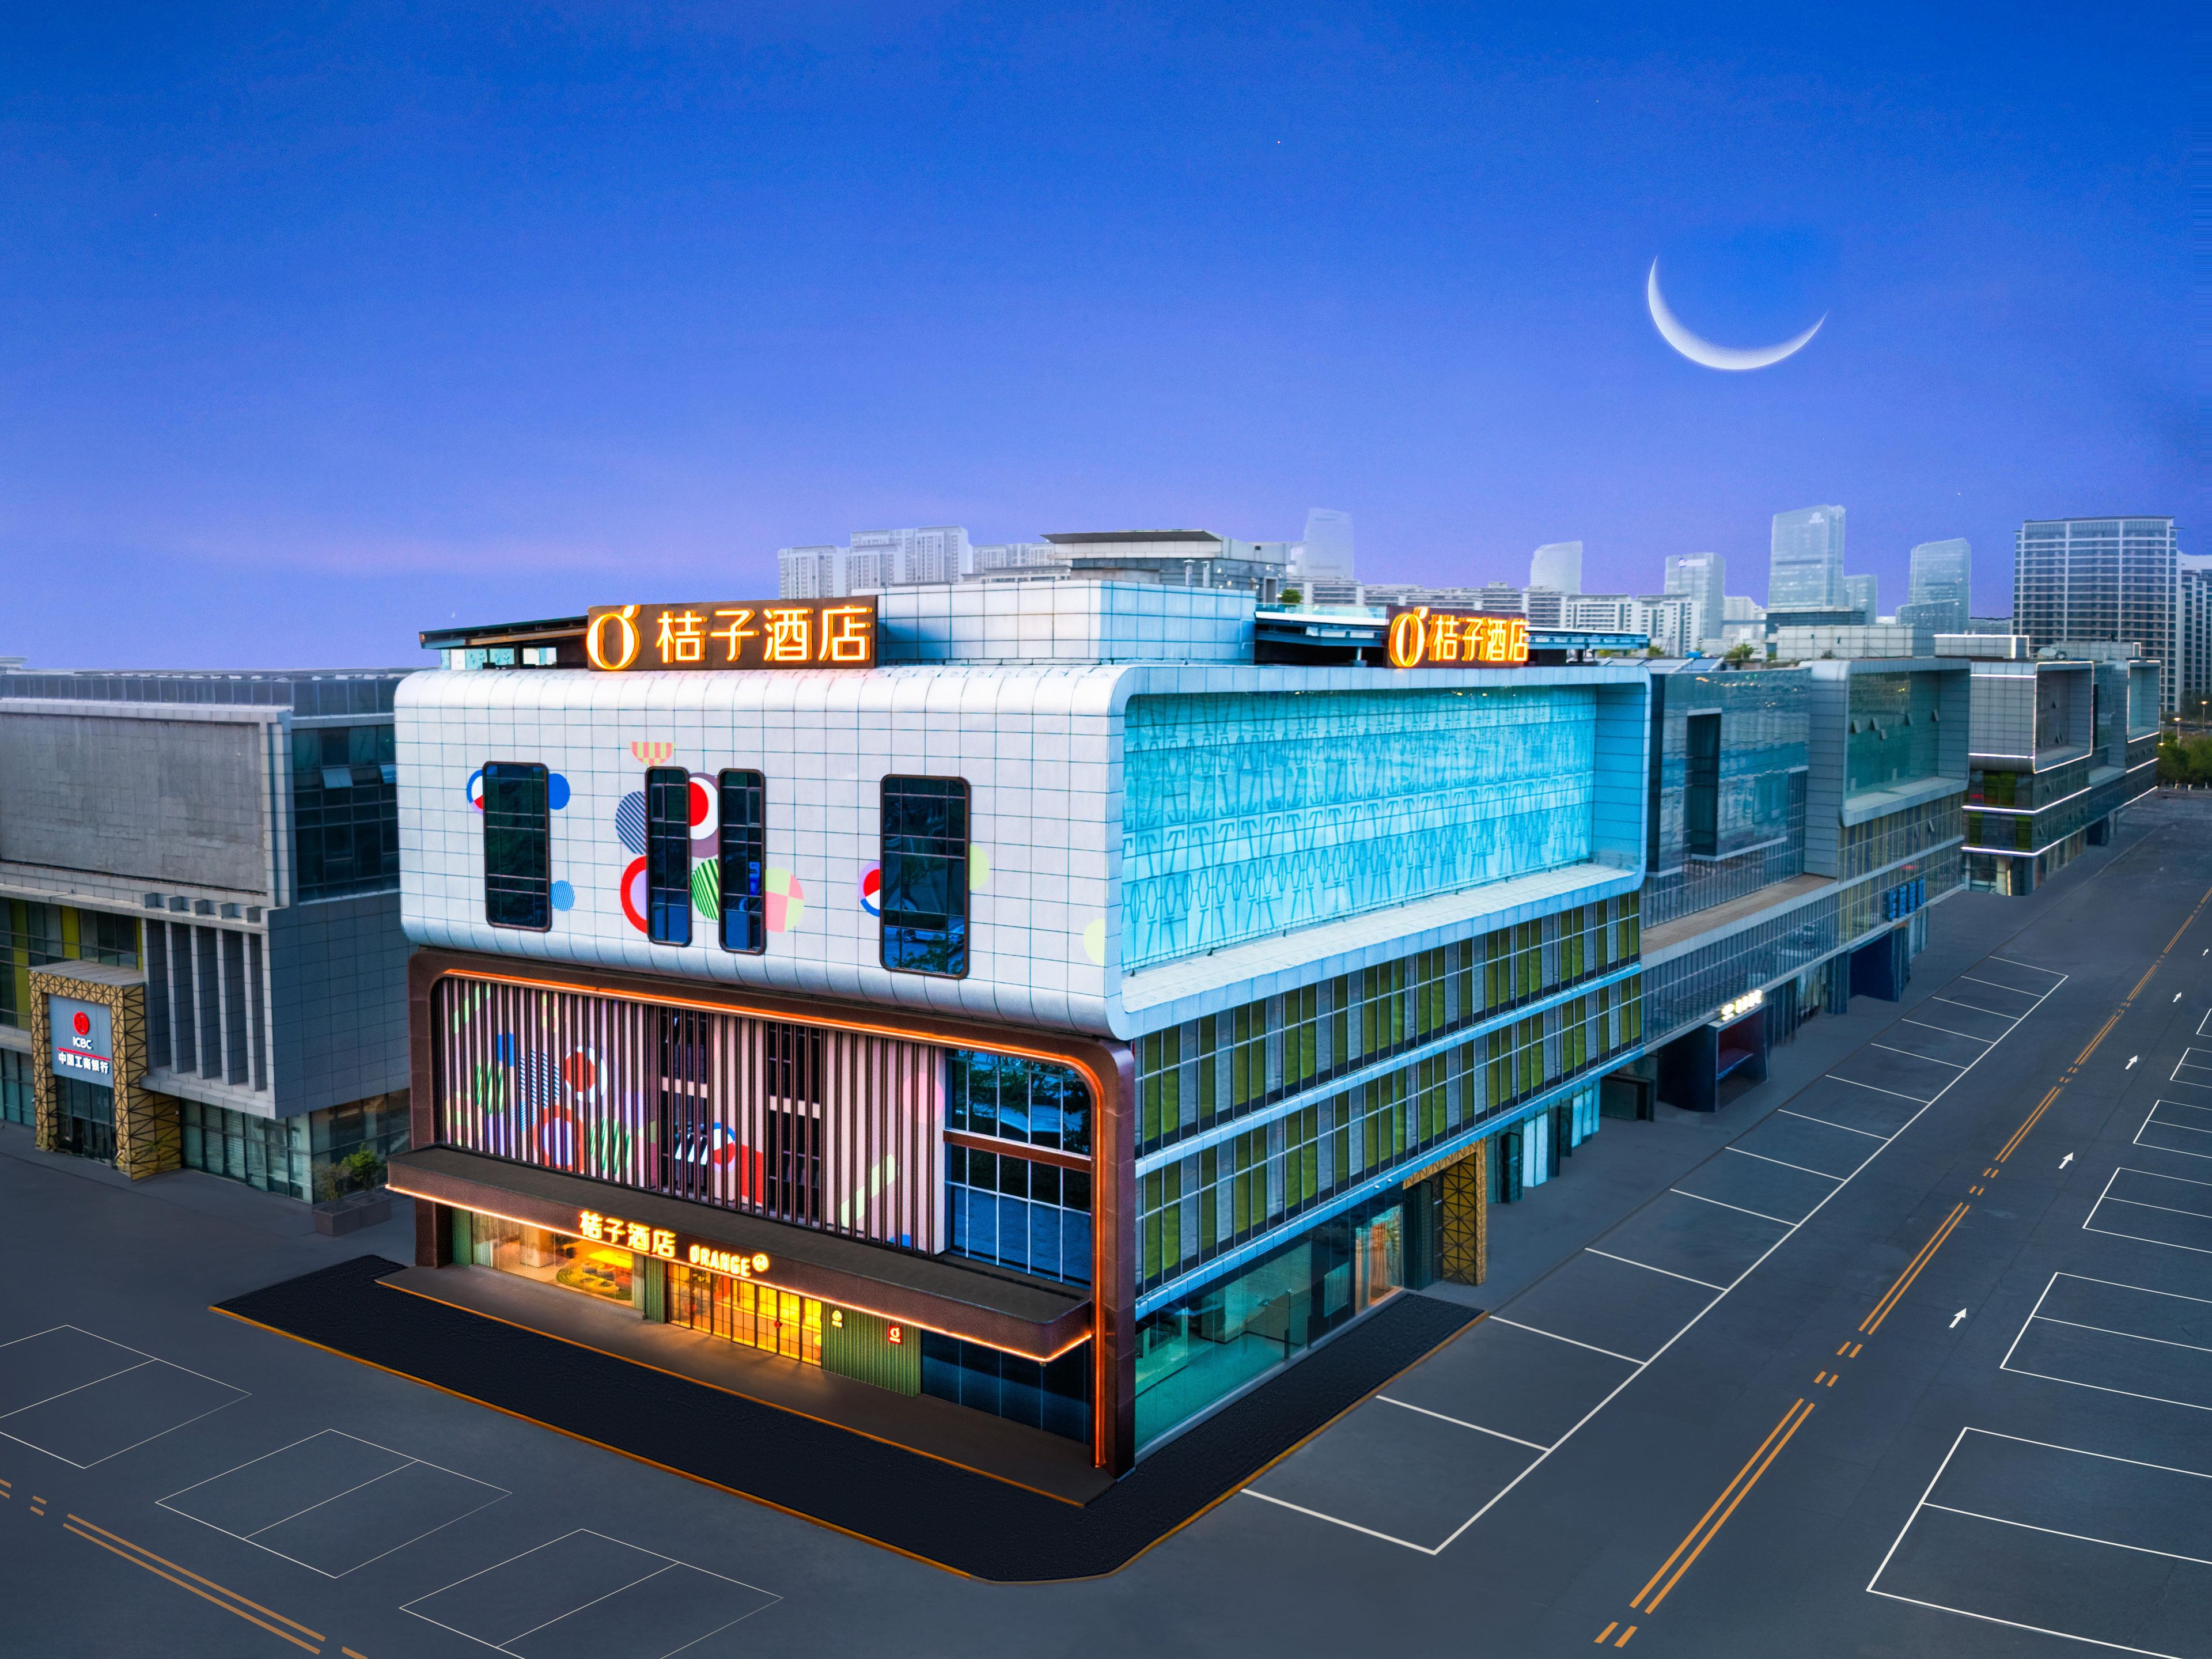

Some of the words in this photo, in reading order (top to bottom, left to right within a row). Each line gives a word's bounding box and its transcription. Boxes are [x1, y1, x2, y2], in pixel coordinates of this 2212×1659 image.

[656, 605, 873, 663] 桔子酒店
[1426, 614, 1530, 662] 桔子酒店
[58, 1052, 109, 1074] 中国工商银行
[73, 1036, 92, 1050] ICBC
[579, 1210, 677, 1259] 桔子酒店
[689, 1244, 751, 1278] ORANGE
